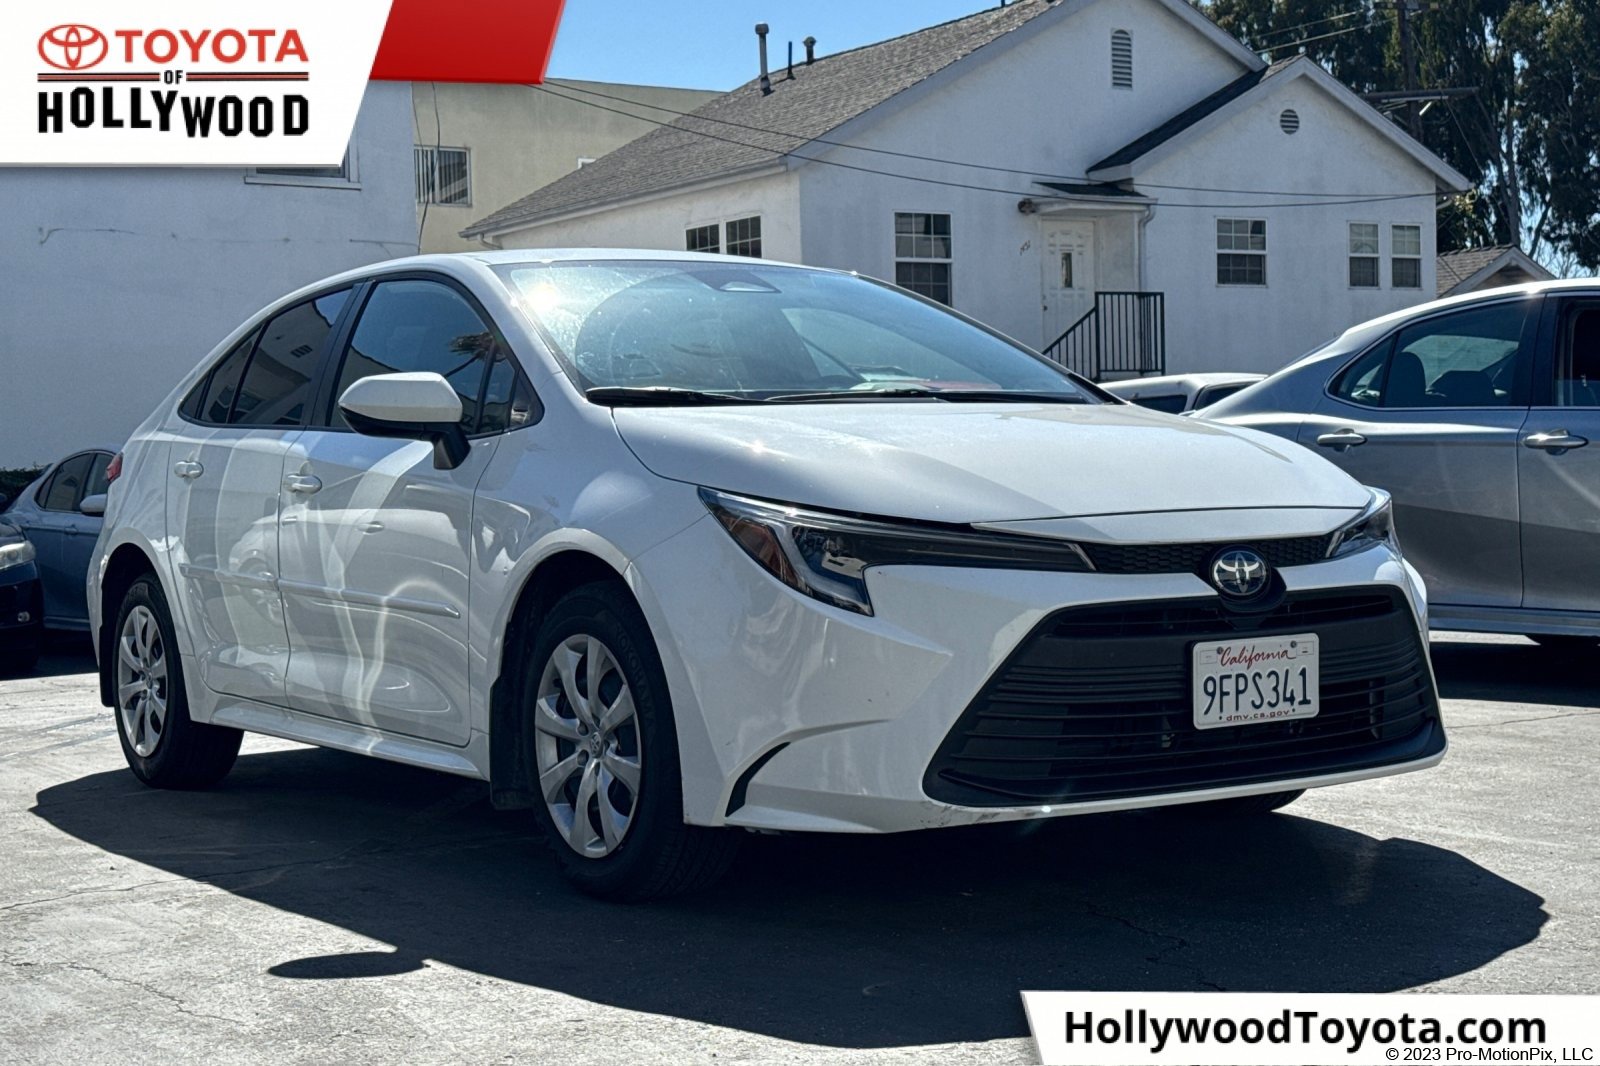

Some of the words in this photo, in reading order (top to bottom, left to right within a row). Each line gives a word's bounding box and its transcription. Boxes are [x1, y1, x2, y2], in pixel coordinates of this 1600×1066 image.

[1220, 644, 1297, 671] California
[1202, 667, 1312, 716] 9FPS341
[1226, 709, 1290, 721] dmv.ca.gov
